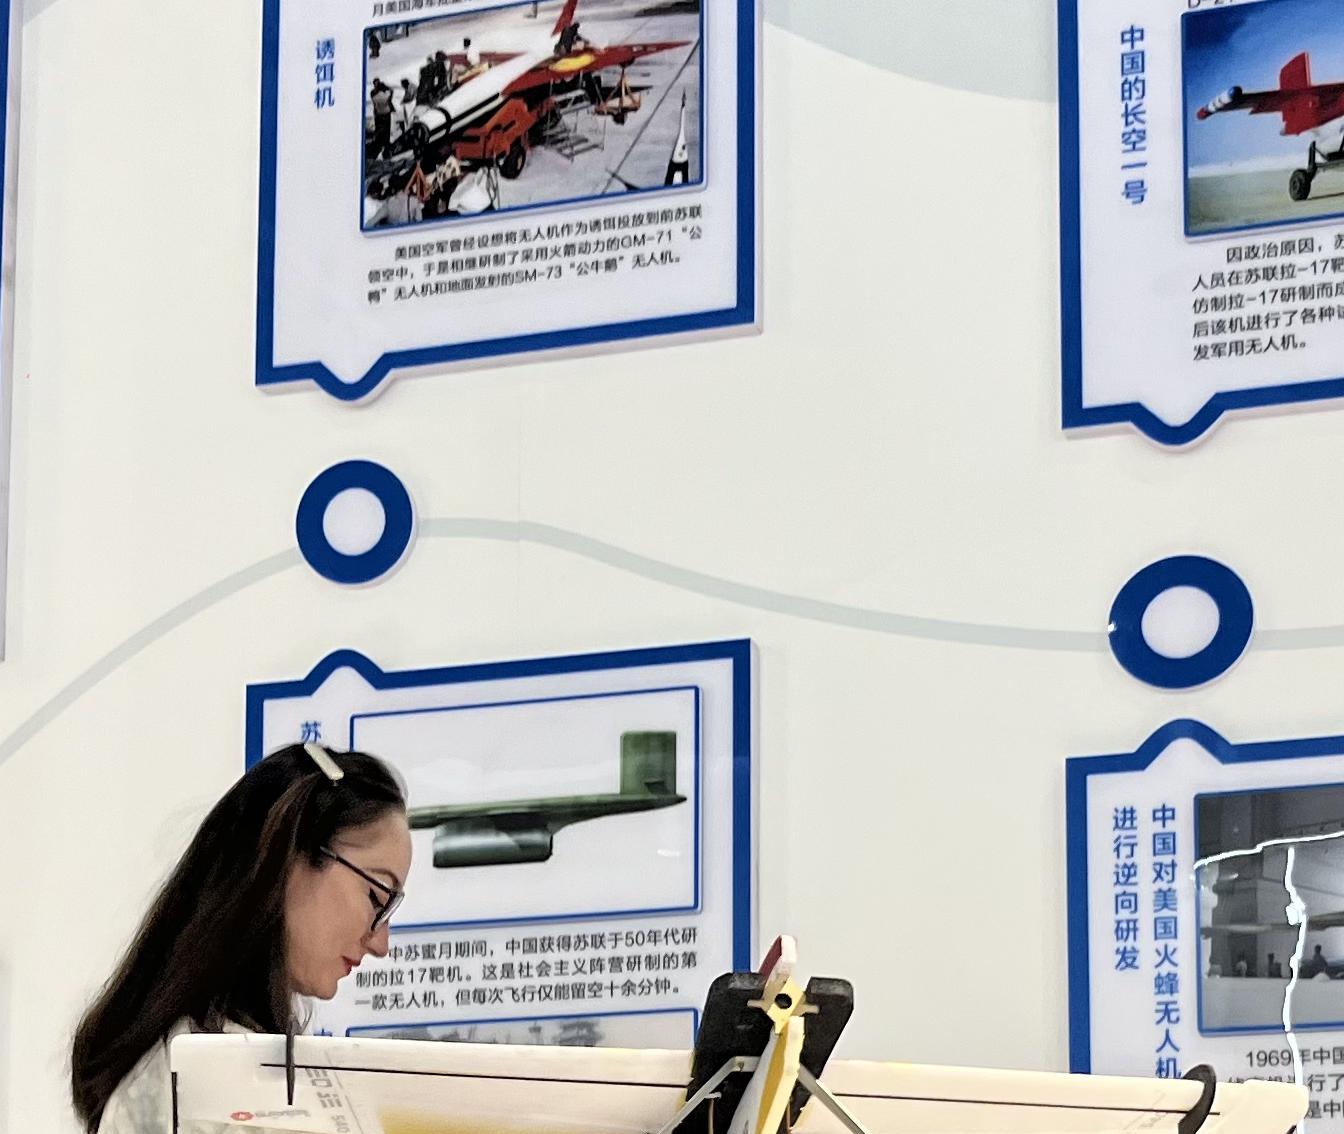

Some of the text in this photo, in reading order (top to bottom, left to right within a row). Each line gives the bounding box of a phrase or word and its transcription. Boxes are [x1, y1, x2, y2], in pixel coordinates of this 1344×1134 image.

[313, 38, 336, 109] 诱饵机
[1120, 25, 1148, 206] 中国的长空一号
[1193, 334, 1309, 361] 发军用无人机。
[300, 720, 323, 744] 苏
[1112, 805, 1140, 972] 进行逆向研发
[1151, 803, 1182, 1079] 中国对美国火蜂无人机
[354, 978, 680, 1010] 一款无人机，但每次飞行仅能留空十余分钟。
